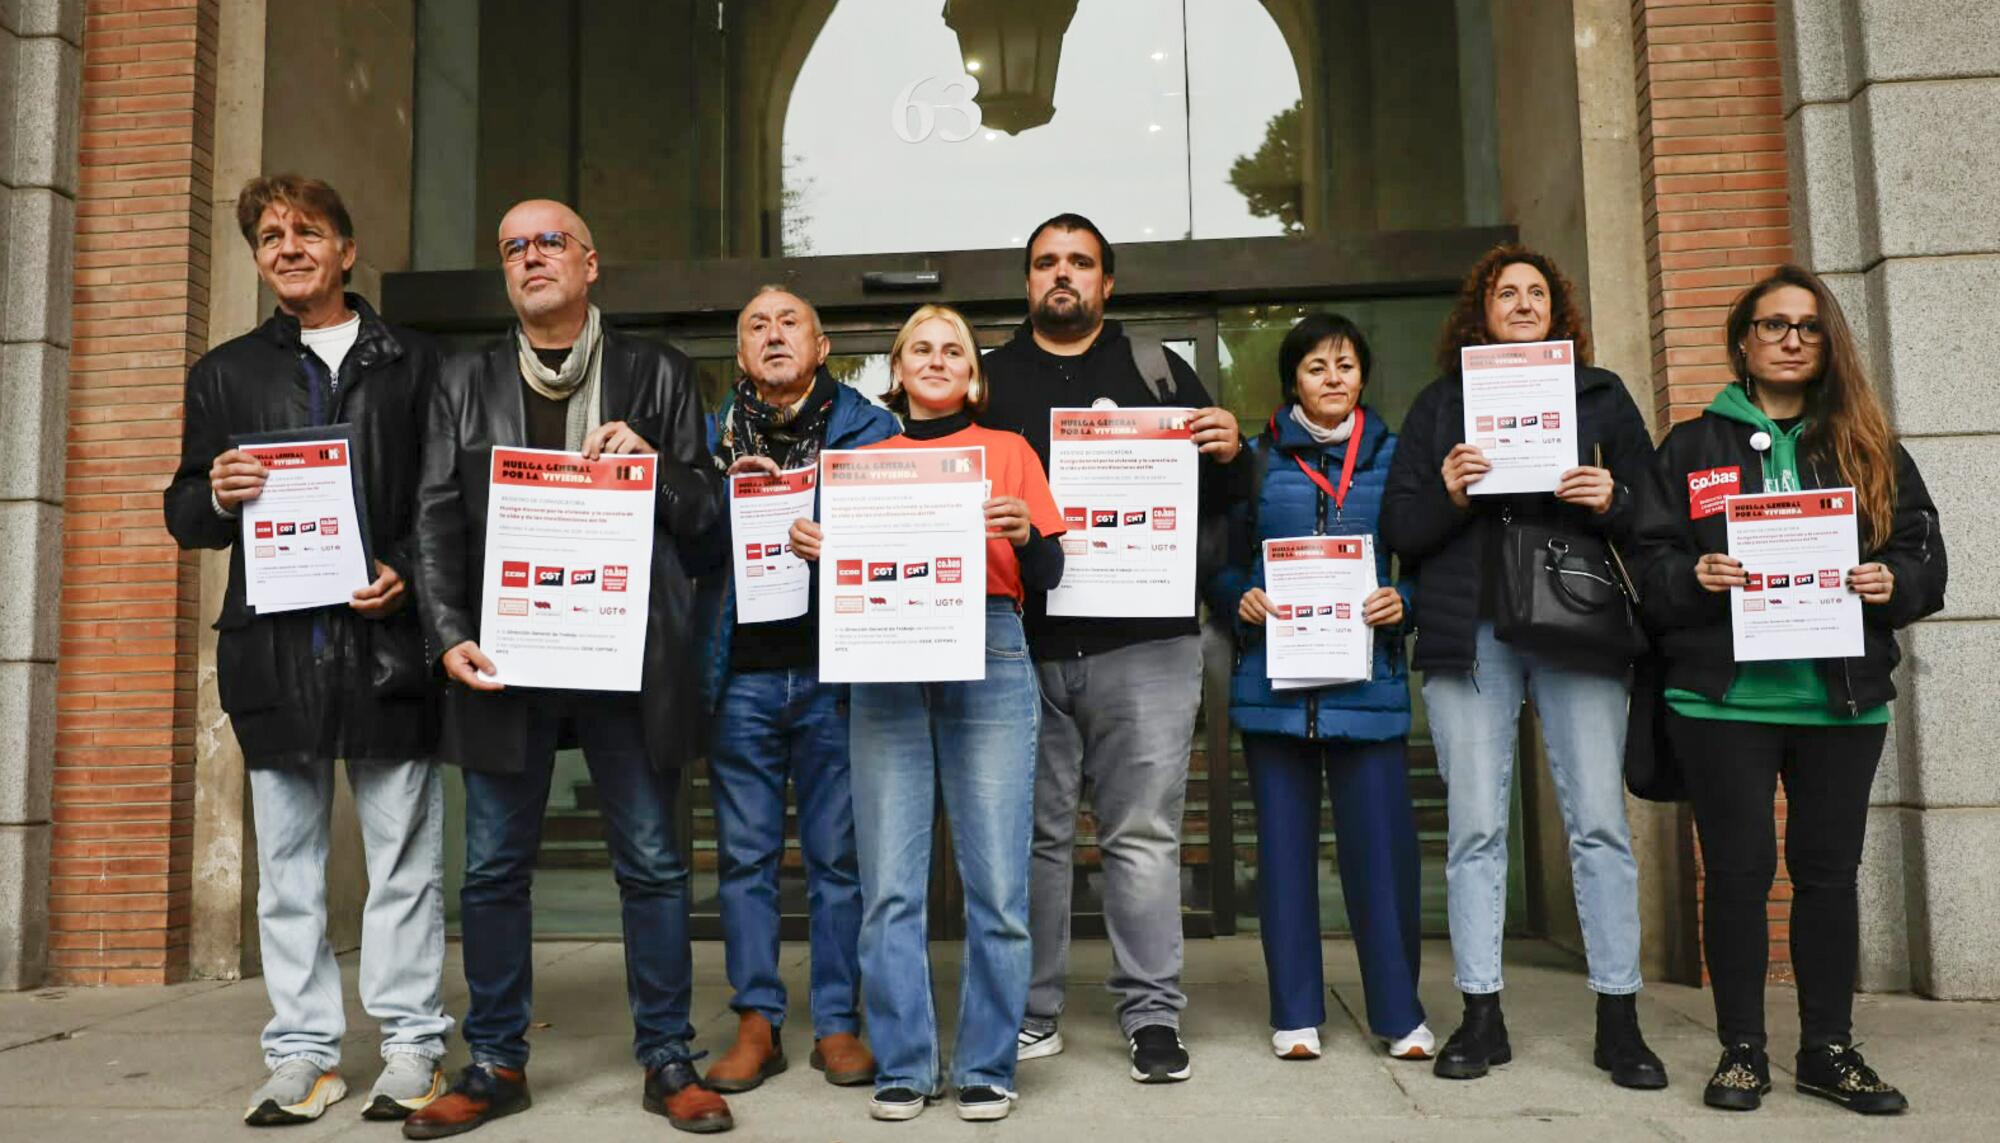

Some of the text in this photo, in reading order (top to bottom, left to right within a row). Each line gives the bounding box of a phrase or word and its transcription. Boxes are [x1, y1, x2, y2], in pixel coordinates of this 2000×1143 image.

[891, 74, 982, 144] 63
[1060, 418, 1136, 427] HUELGA GENERAL
[1093, 426, 1138, 435] VIVIENDA
[502, 460, 592, 473] HUELGA GENERAL
[832, 461, 917, 471] HUELGA GENERAL
[502, 470, 593, 484] POR LA VIVIENDA
[832, 470, 919, 480] POR LA VIVIENDA
[1690, 470, 1738, 491] co.bas
[1735, 501, 1801, 511] HUELGA GENERAL
[1763, 508, 1802, 516] VIVIENDA
[1096, 514, 1114, 523] CGT
[1126, 514, 1144, 523] CNT
[873, 567, 893, 576] CGT
[906, 566, 926, 575] CNT
[539, 571, 561, 581] CGT
[573, 573, 593, 582] CNT
[935, 598, 954, 606] UGT
[600, 606, 618, 615] UGT
